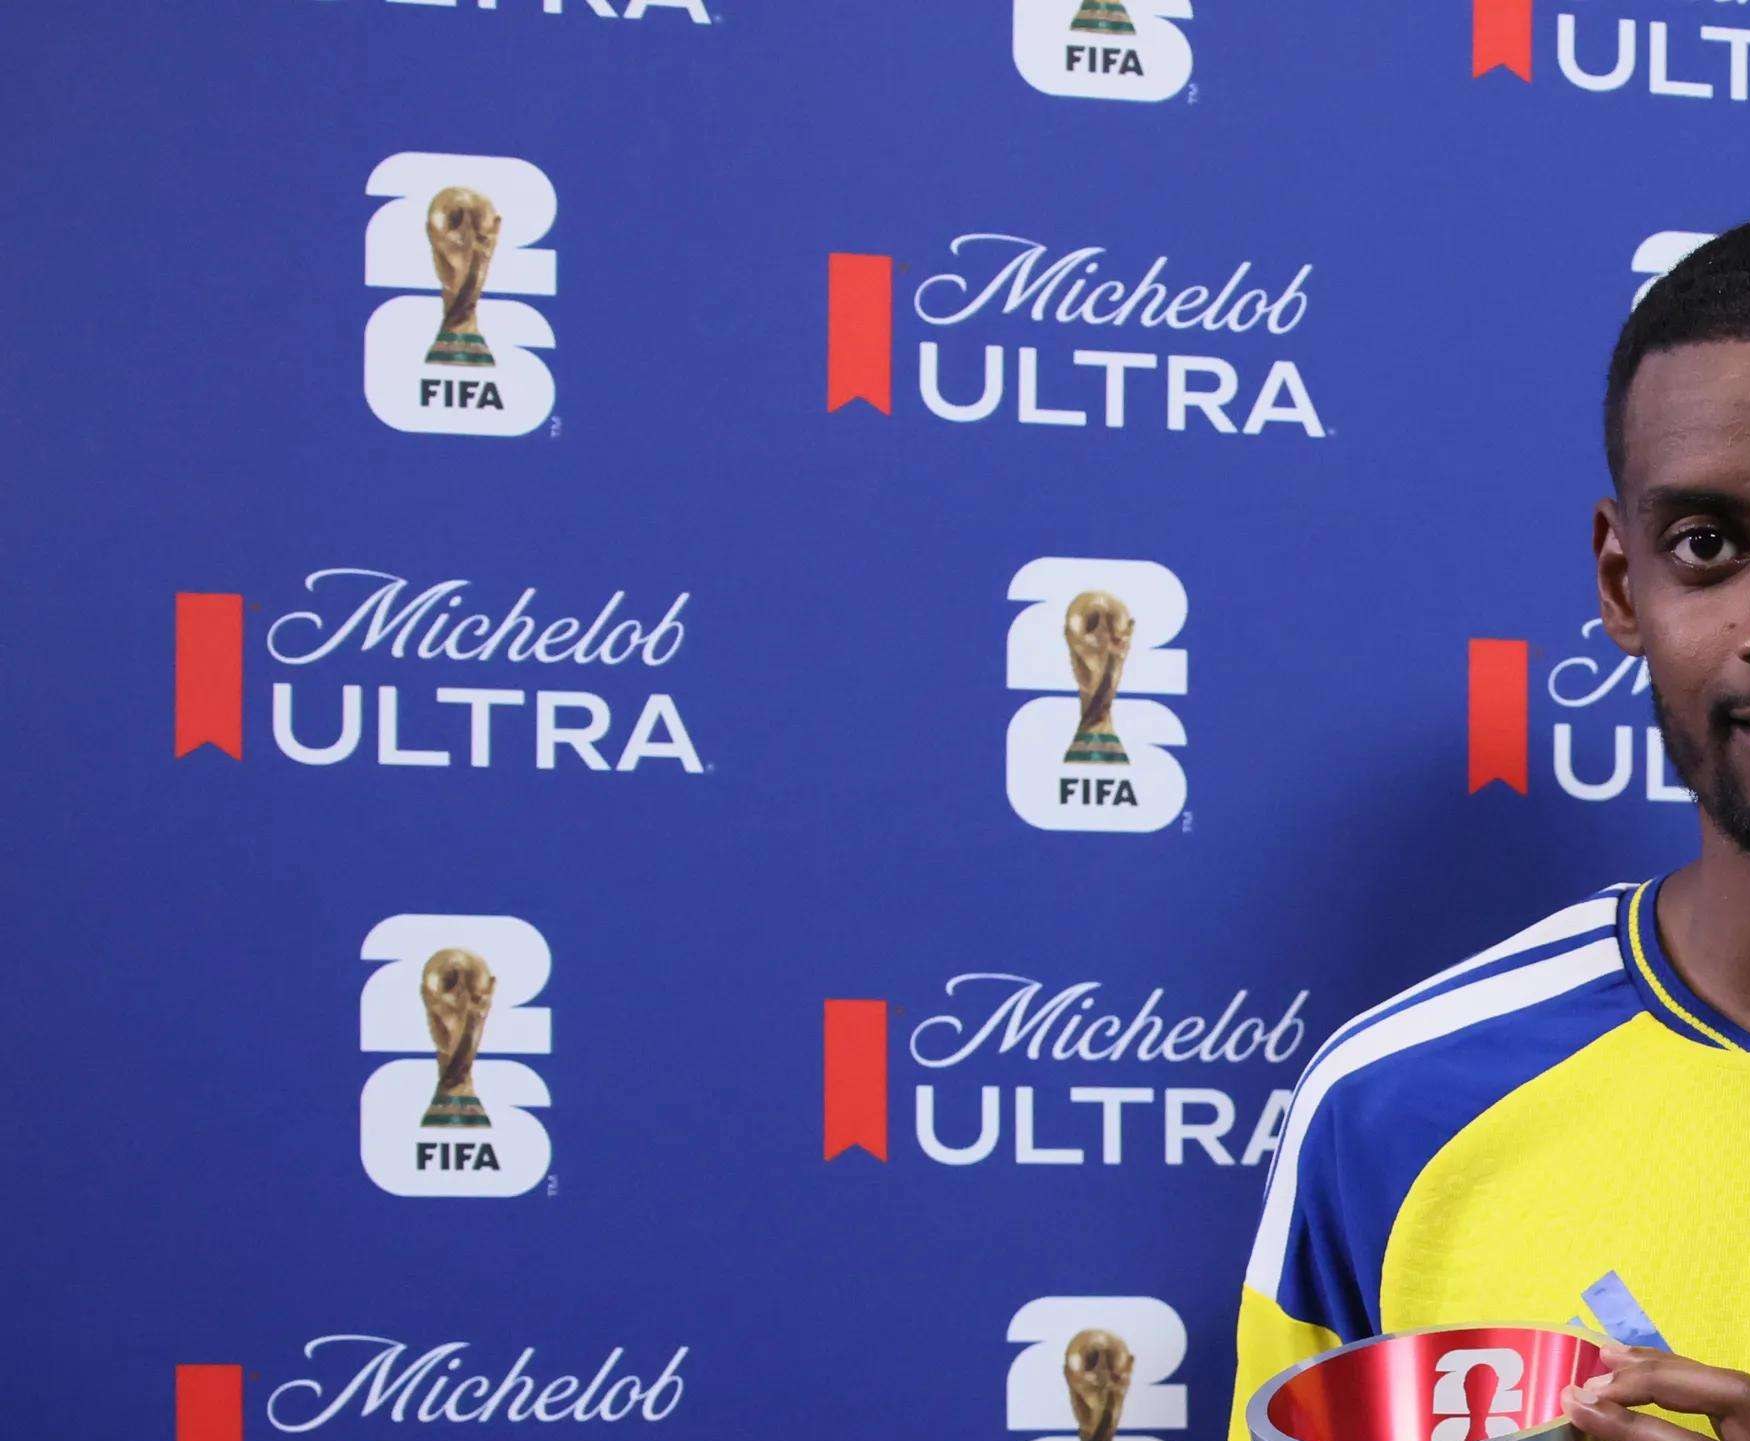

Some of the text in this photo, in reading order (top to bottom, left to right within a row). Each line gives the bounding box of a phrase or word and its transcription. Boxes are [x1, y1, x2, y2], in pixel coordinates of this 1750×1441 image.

[1067, 45, 1143, 76] FIFA
[914, 234, 1312, 334] Michelob
[421, 379, 503, 410] FIFA
[919, 341, 1326, 437] ULTRA
[267, 568, 690, 666] Michelob
[273, 683, 704, 773] ULTRA
[1060, 778, 1137, 806] FIFA
[910, 973, 1308, 1068] Michelob
[417, 1143, 500, 1170] FIFA
[267, 1335, 689, 1432] Michelob
